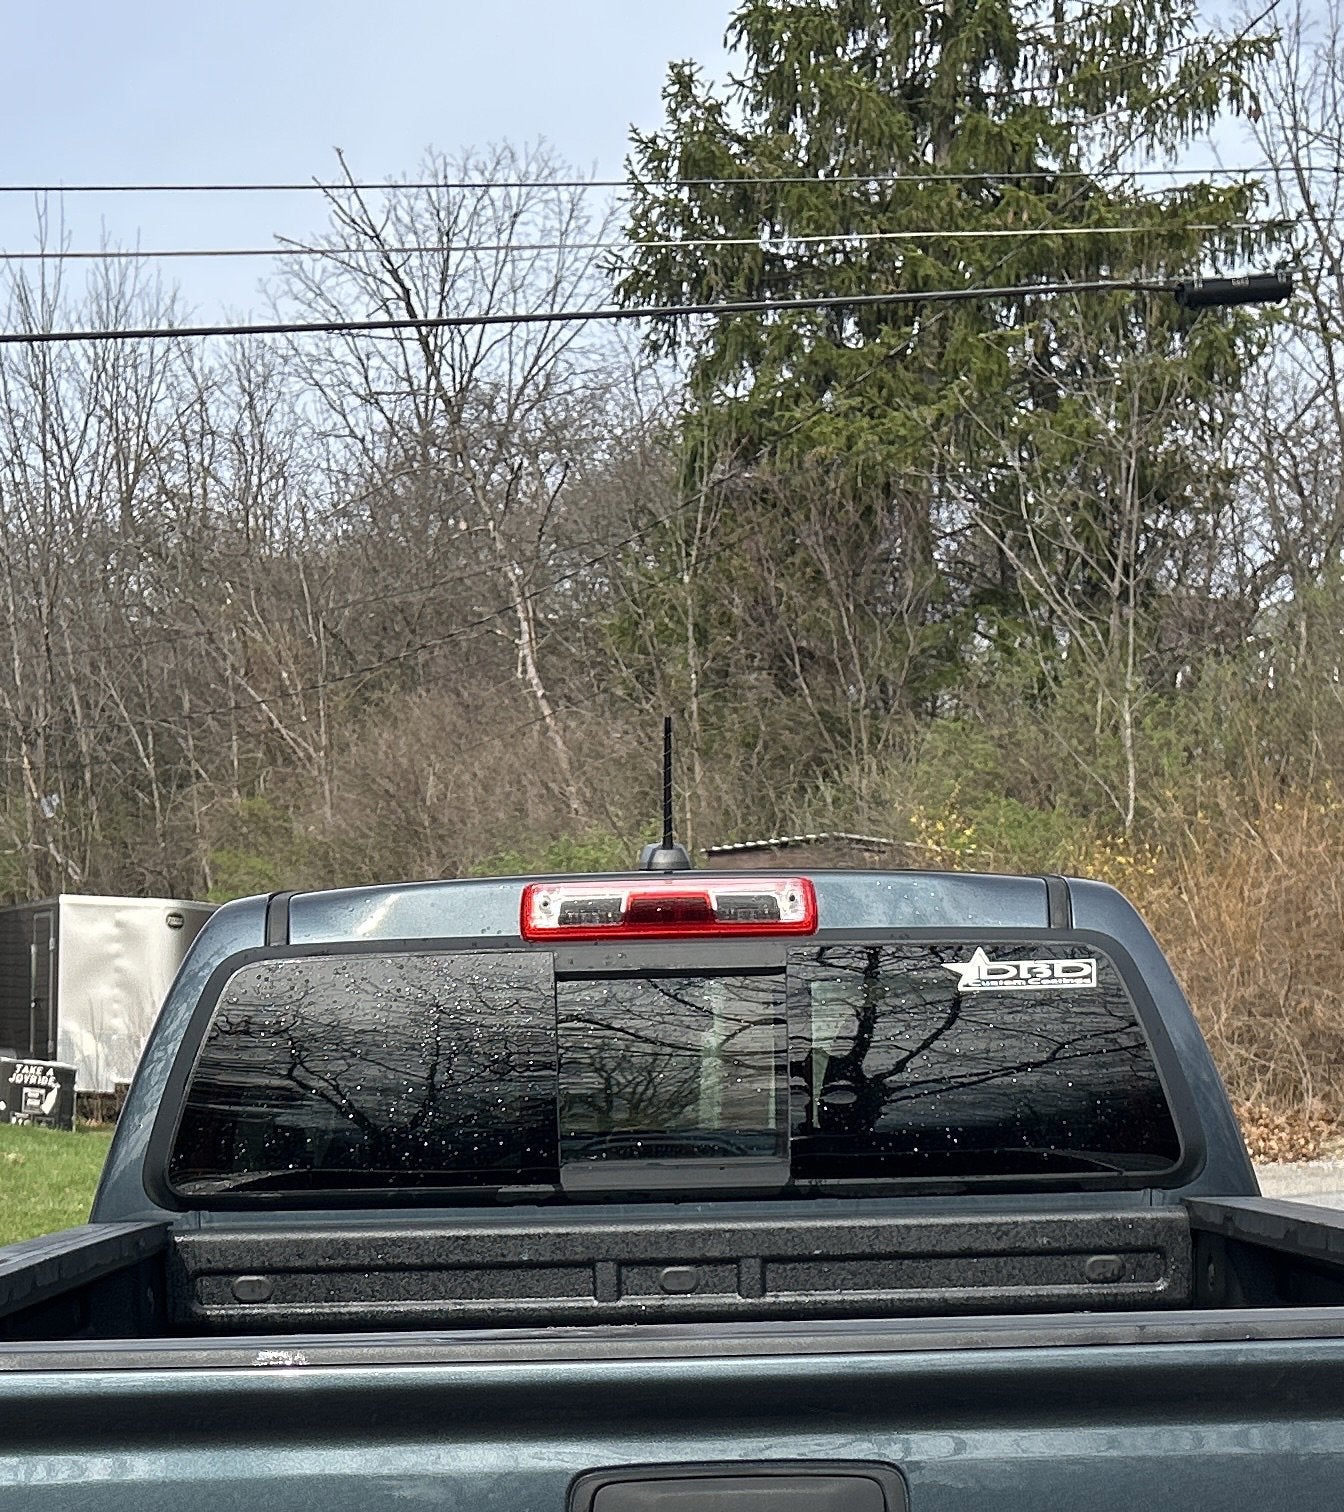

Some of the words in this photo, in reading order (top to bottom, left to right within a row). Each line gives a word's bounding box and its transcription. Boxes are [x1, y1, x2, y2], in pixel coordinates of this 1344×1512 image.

[979, 962, 1092, 980] DBD
[970, 978, 1026, 987] Custom
[15, 1064, 44, 1075] TAKE
[46, 1068, 54, 1076] A
[8, 1073, 56, 1086] JOYRIDE
